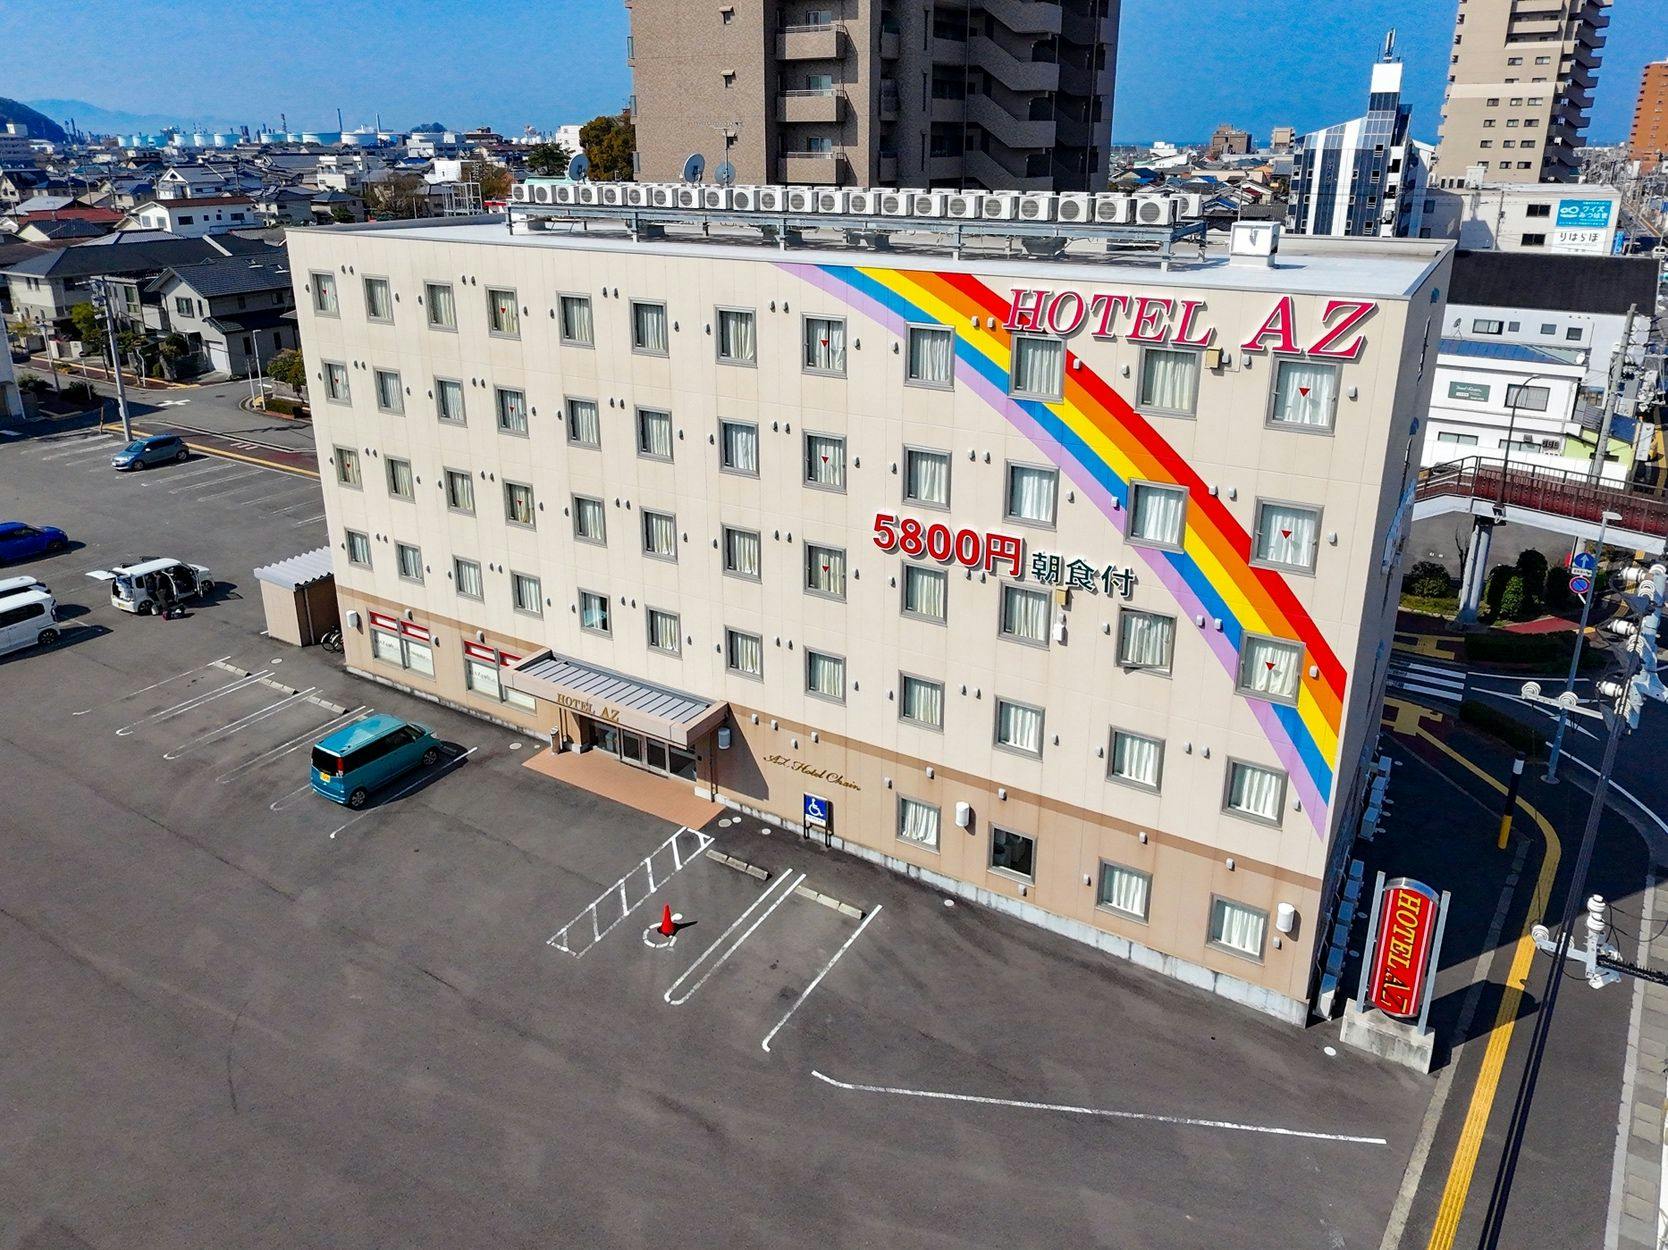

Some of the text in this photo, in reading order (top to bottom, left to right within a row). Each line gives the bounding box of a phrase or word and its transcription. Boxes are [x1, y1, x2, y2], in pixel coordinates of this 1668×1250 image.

[1003, 287, 1377, 359] HOTEL AZ
[872, 512, 1136, 597] 5800円 朝食付
[557, 693, 620, 722] HOTEL AZ
[763, 754, 862, 791] AZ Hotel Chain
[1380, 889, 1421, 1014] HOTEL AZ
